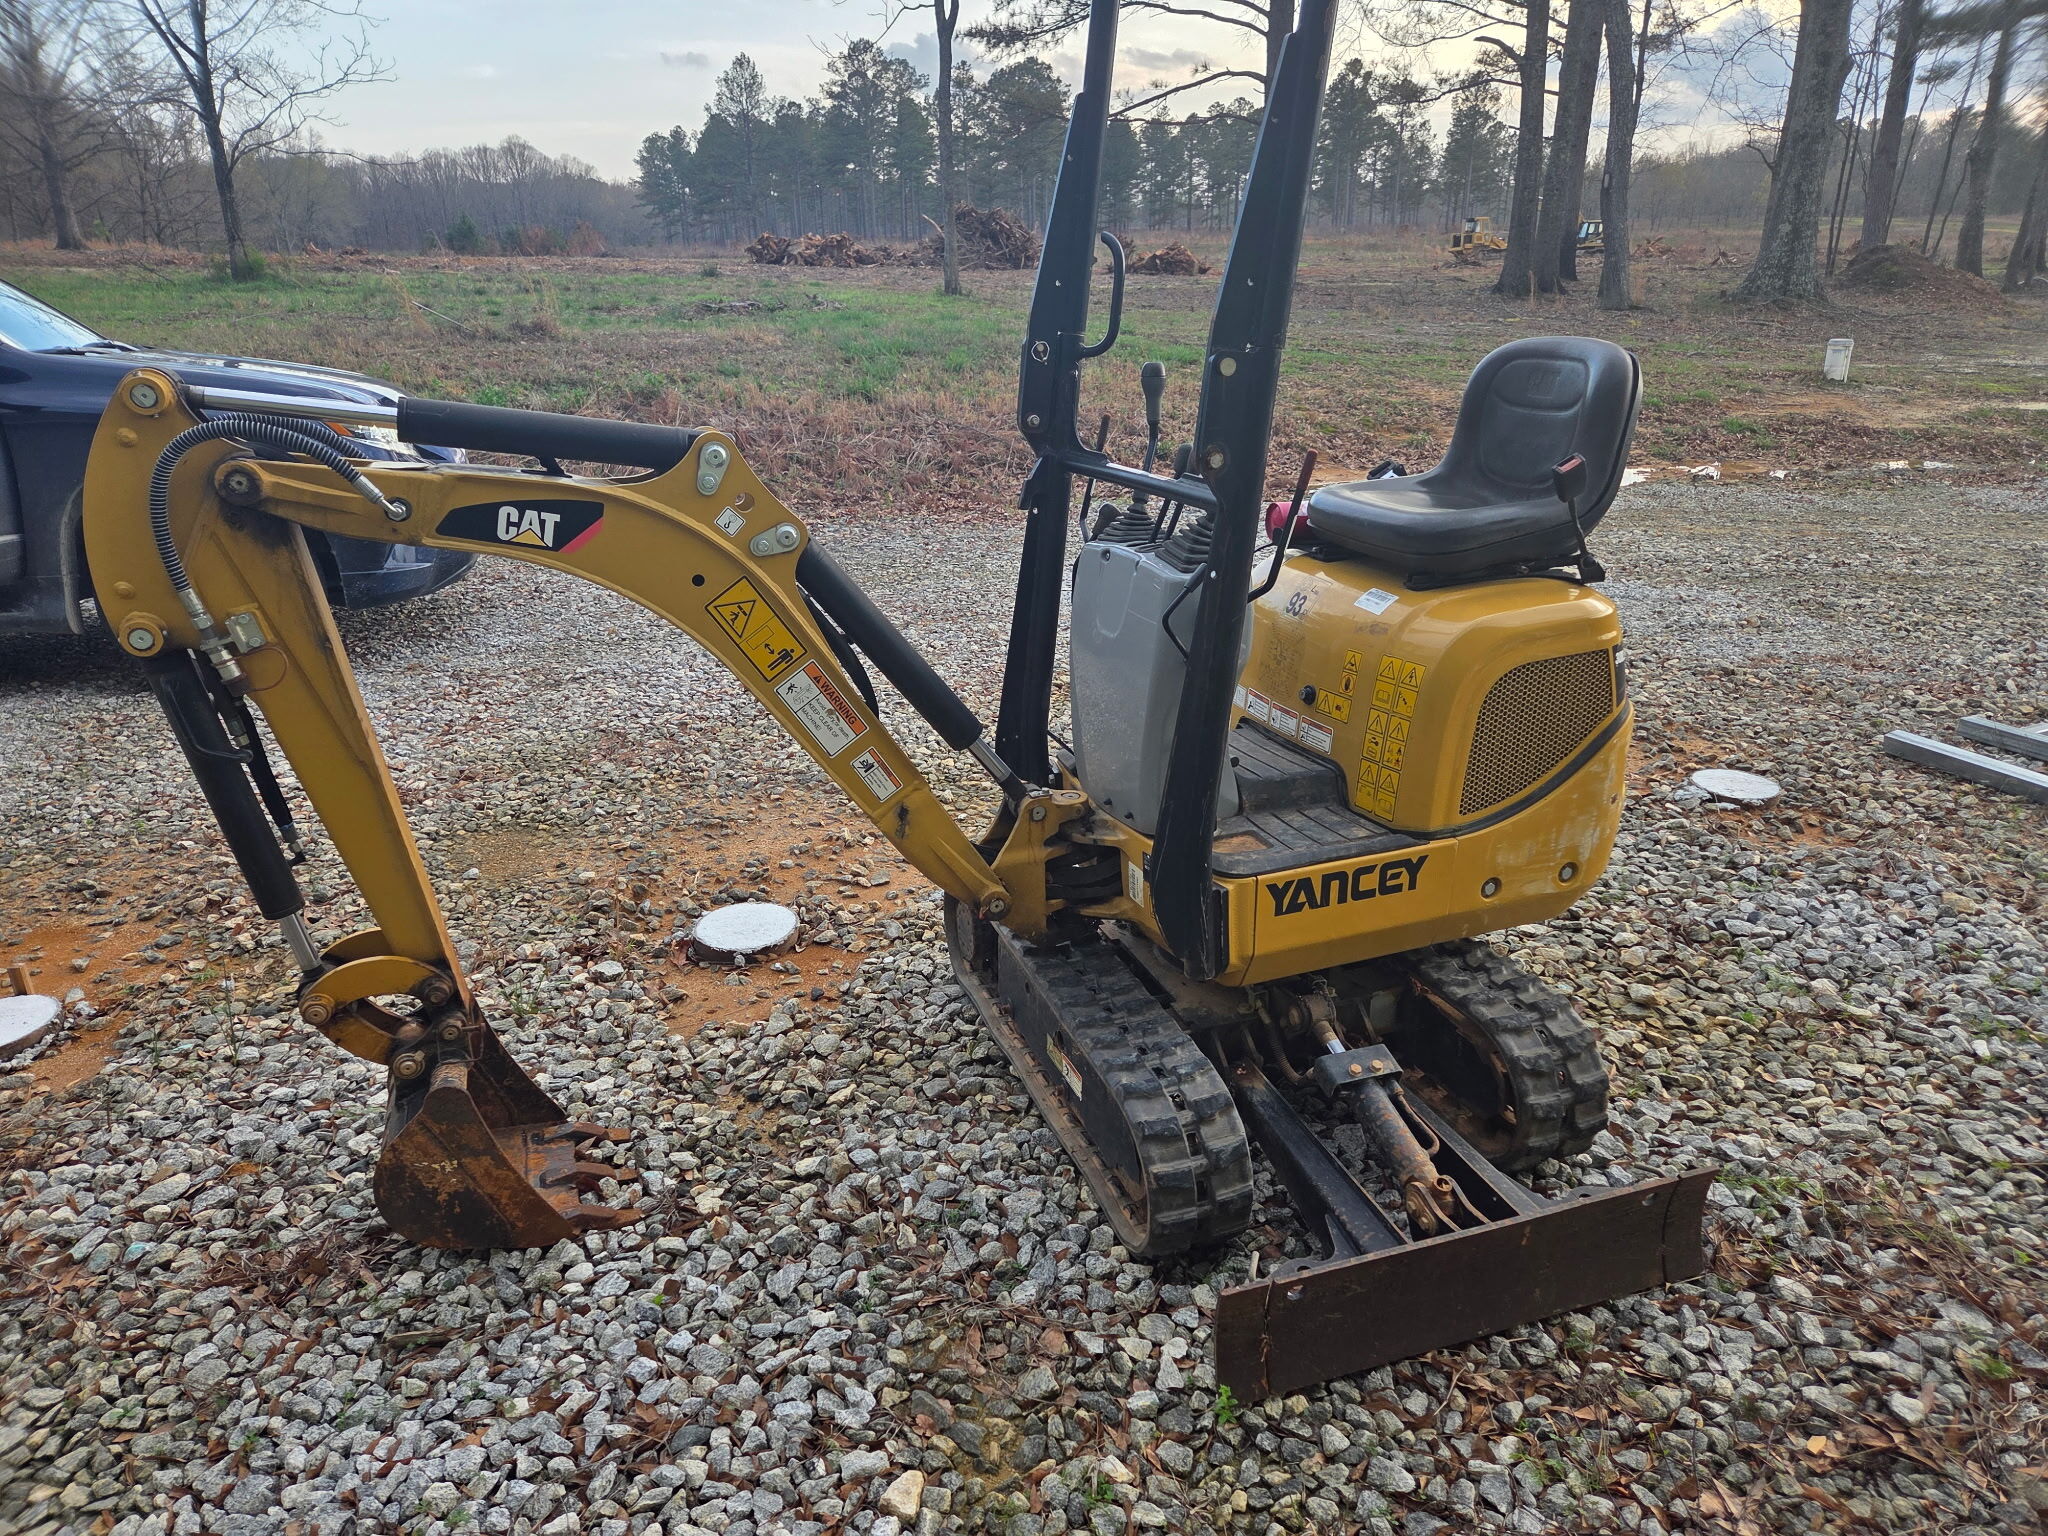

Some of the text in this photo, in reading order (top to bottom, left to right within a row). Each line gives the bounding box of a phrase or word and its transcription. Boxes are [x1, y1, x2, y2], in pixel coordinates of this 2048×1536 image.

[497, 506, 560, 548] CAT
[1285, 591, 1308, 617] 93
[808, 703, 821, 716] KEEP
[818, 715, 834, 732] CLEAR
[820, 681, 857, 725] WARNING
[1265, 854, 1429, 917] YANCEY
